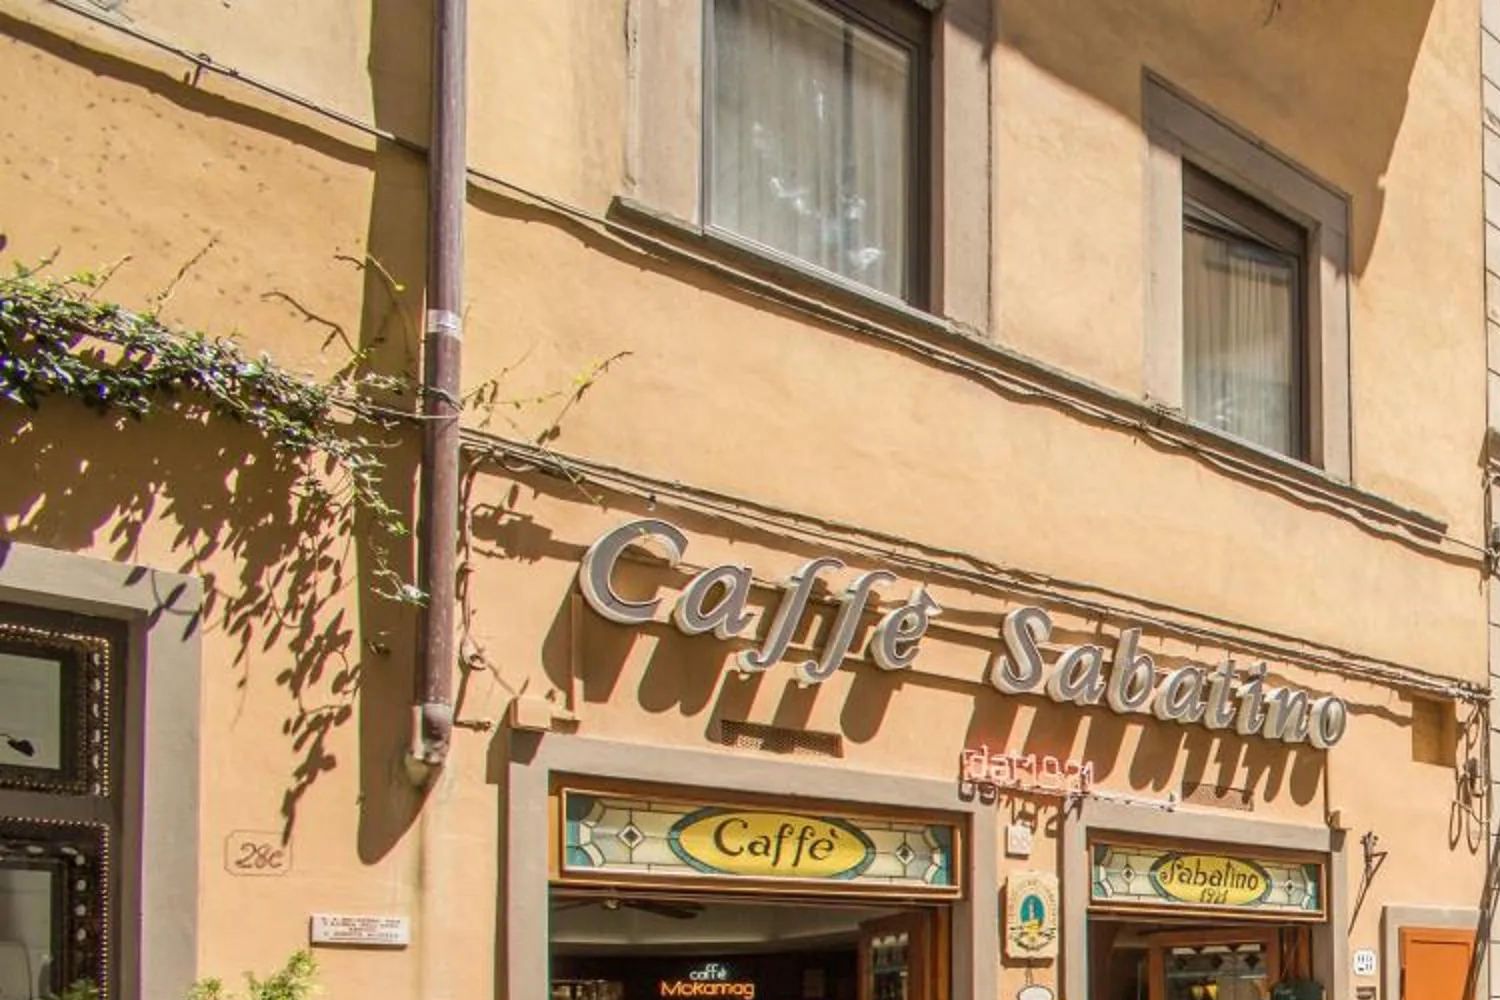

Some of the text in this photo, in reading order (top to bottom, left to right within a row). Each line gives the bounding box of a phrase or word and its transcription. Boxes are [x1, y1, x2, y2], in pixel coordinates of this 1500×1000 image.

[579, 517, 1347, 749] Caffè Sabatino
[714, 818, 839, 867] Caffè
[1160, 858, 1259, 891] Sabatino
[660, 980, 755, 1000] Mokamag
